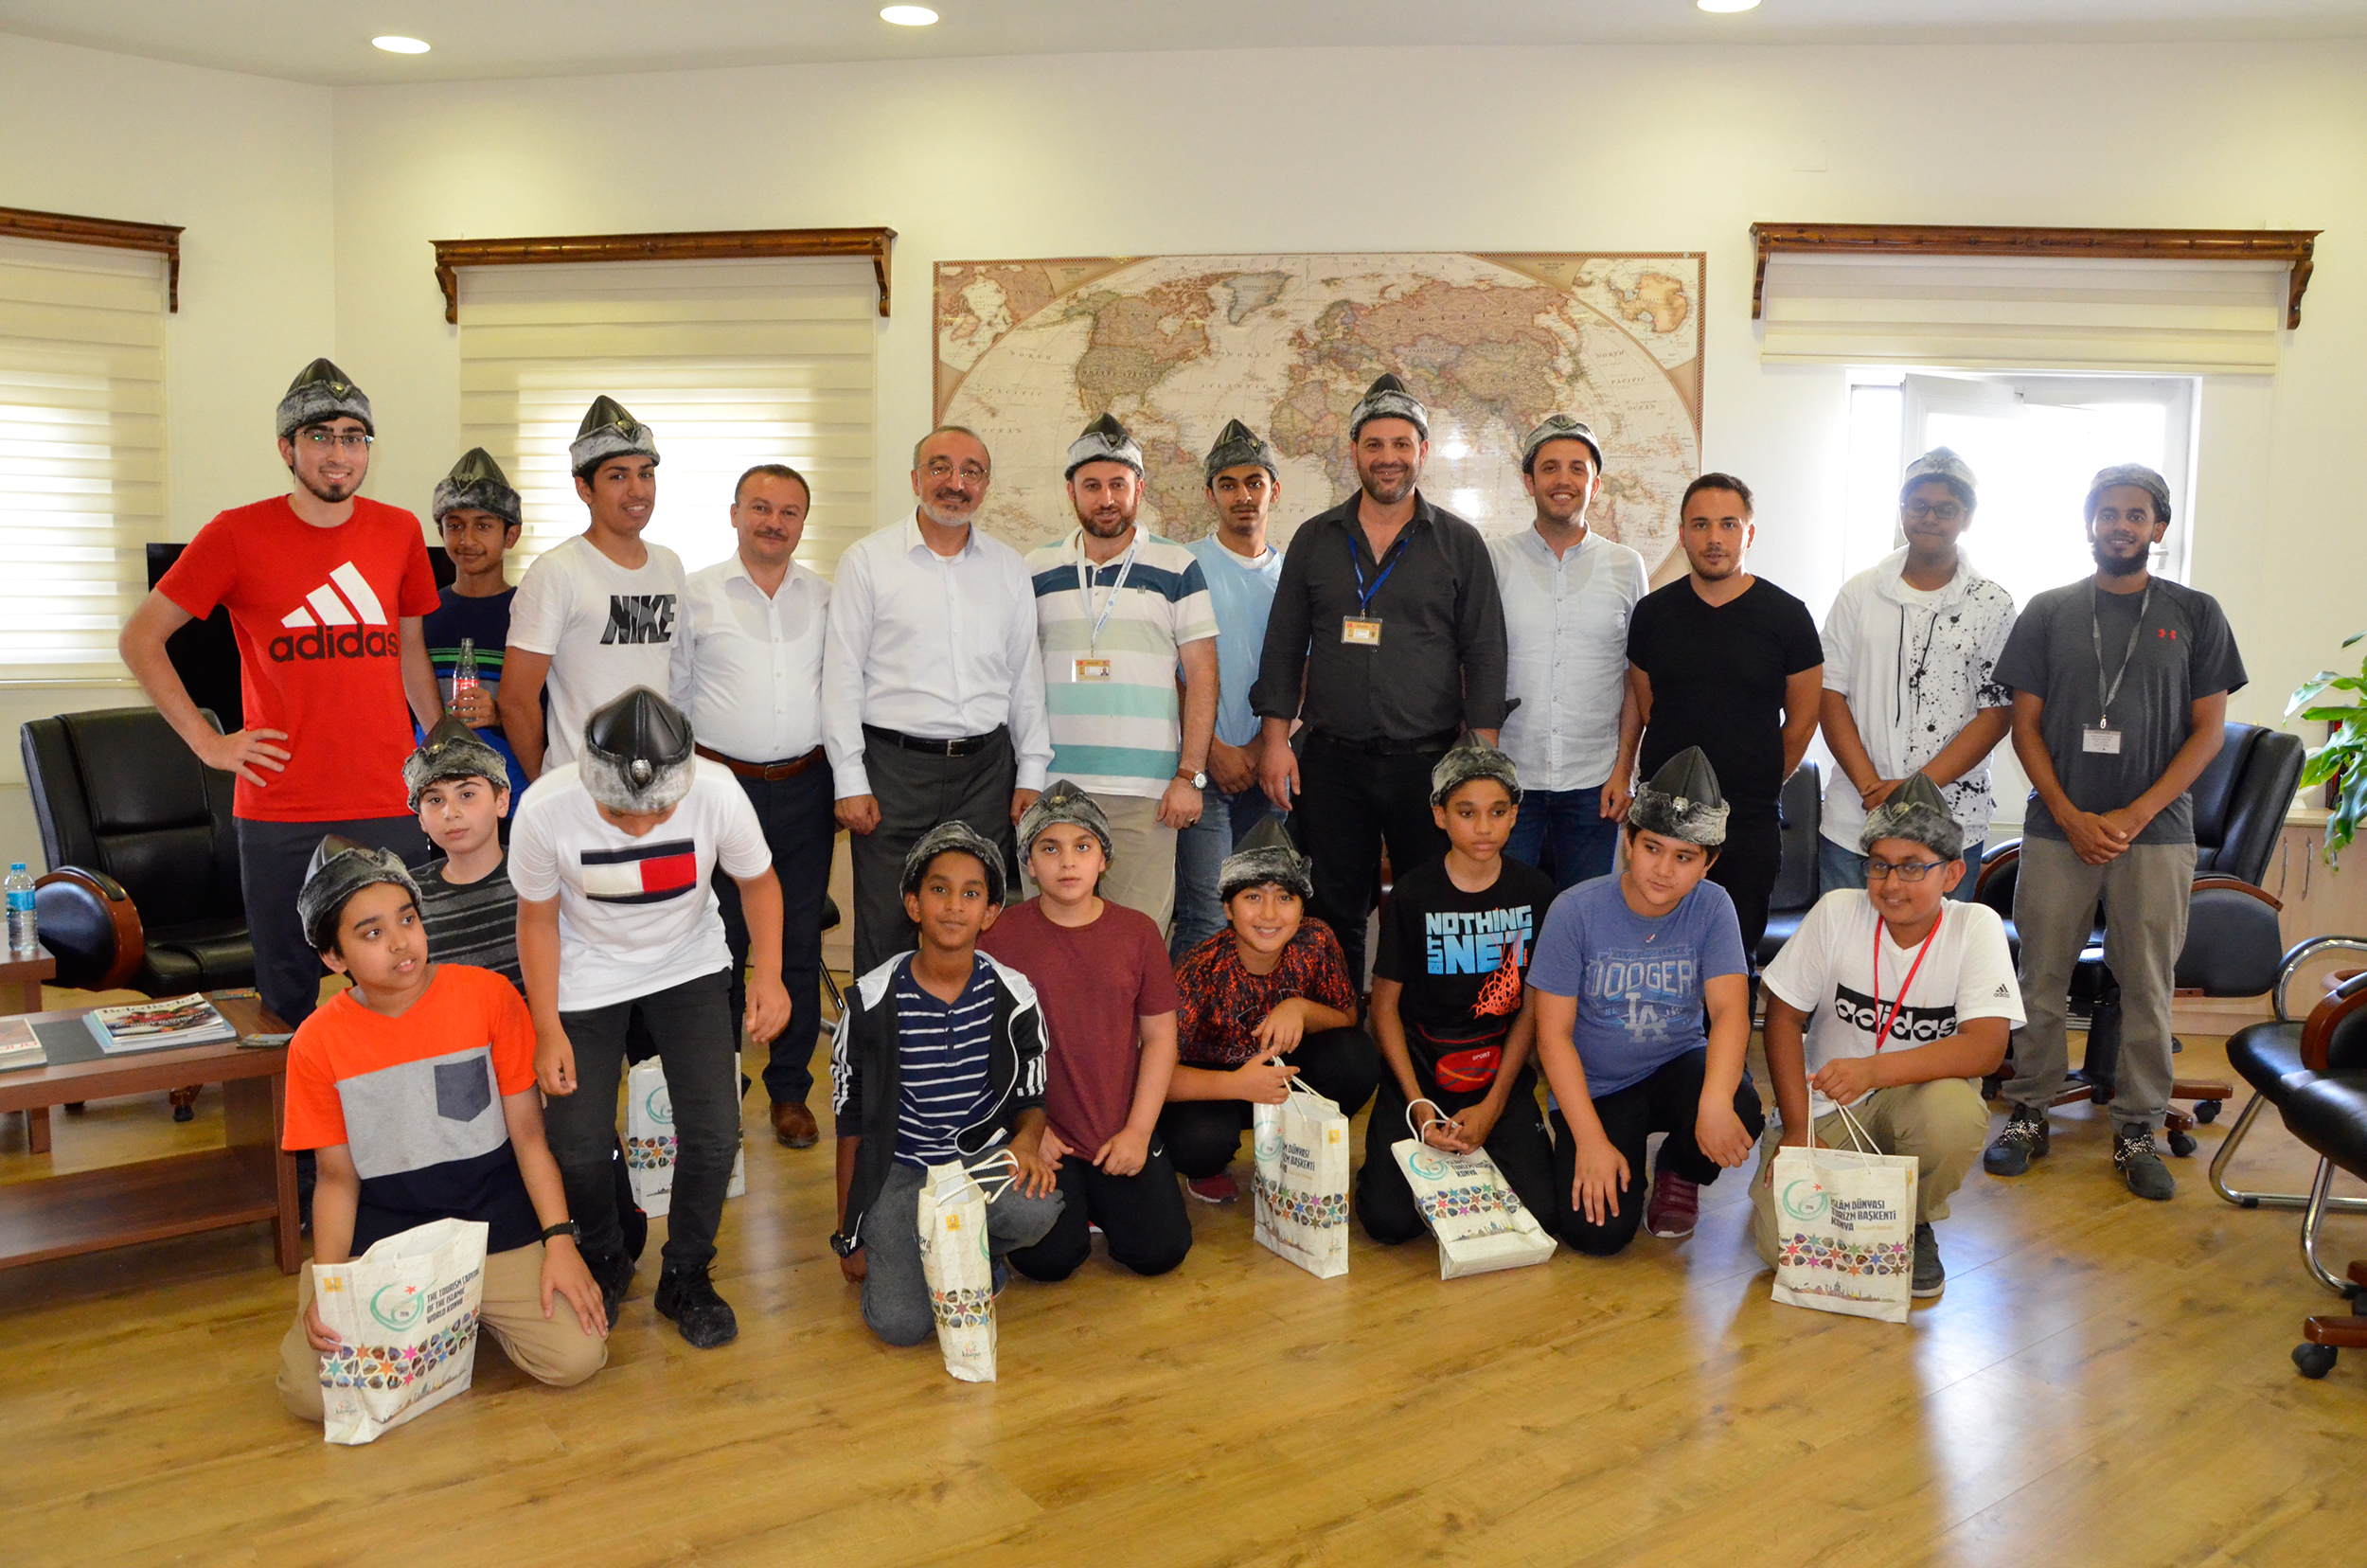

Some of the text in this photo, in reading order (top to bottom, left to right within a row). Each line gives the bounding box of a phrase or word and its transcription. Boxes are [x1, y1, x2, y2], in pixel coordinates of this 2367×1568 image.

[1397, 310, 1508, 324] RUSSIA
[1009, 350, 1053, 362] NORTH
[1595, 349, 1626, 359] NORTH
[1611, 376, 1646, 384] PACIFIC
[599, 594, 677, 645] NIKE
[269, 623, 400, 663] adidas
[1425, 905, 1532, 935] NOTHING
[1427, 935, 1444, 974] BUT
[1443, 928, 1532, 974] NET
[1624, 992, 1670, 1042] LA
[1835, 998, 1958, 1042] adidas
[1472, 1051, 1490, 1060] SPORT
[1455, 1169, 1478, 1178] KONYA
[1852, 1198, 1885, 1210] DÜNYASI
[1830, 1216, 1855, 1231] KONYA
[1857, 1210, 1896, 1221] BAŞKENTİ
[427, 1291, 437, 1303] THE
[438, 1277, 462, 1297] TOURISM
[427, 1286, 465, 1314] OF THE ISLAMIC
[426, 1297, 463, 1324] WORLD KONYA
